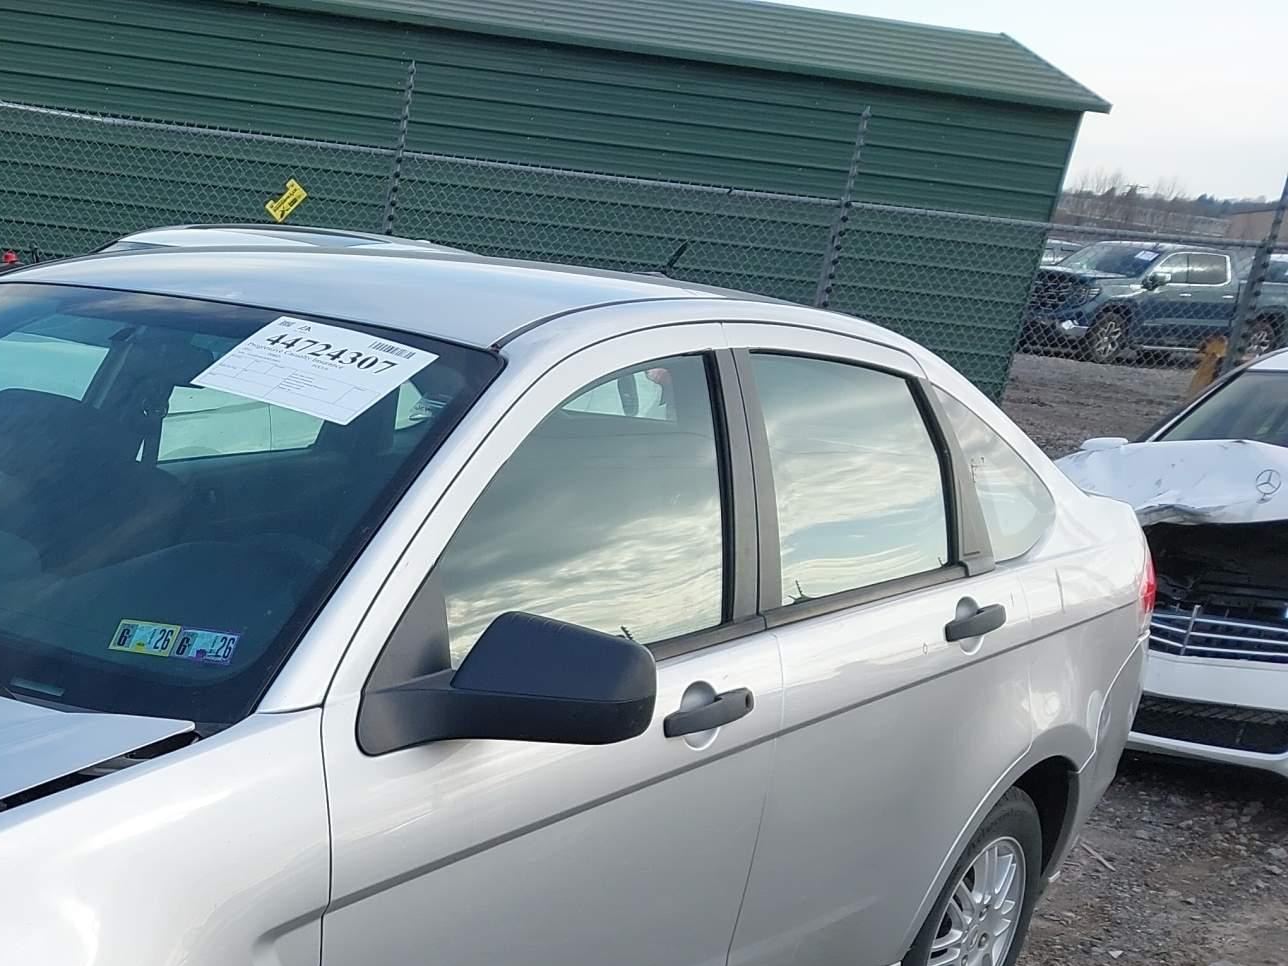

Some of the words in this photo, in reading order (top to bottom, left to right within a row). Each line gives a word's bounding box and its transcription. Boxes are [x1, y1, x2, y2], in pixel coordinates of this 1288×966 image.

[266, 333, 398, 374] 44724307
[117, 628, 130, 646] 6
[152, 629, 174, 650] 26
[214, 636, 236, 659] 26
